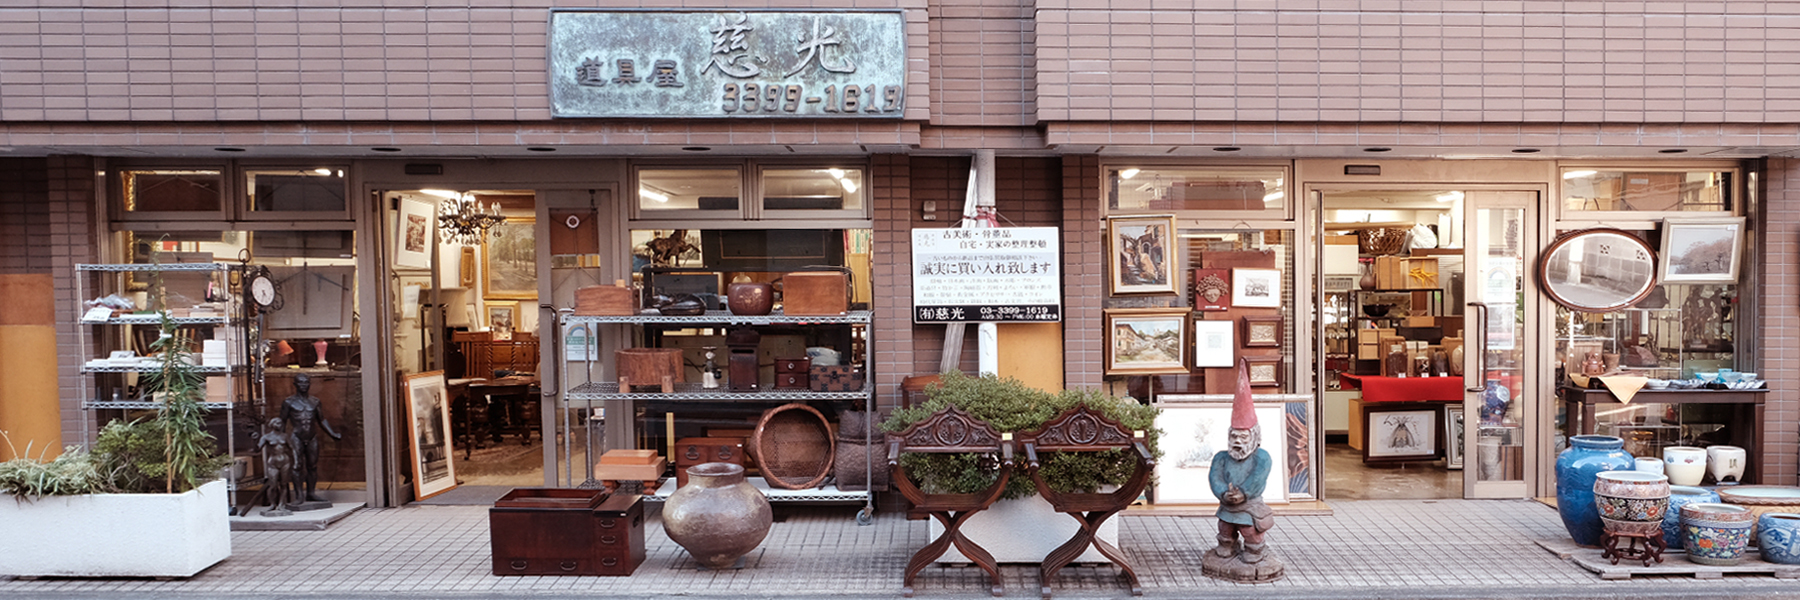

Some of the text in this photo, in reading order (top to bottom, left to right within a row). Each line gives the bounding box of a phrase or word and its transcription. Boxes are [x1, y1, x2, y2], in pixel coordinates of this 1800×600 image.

[575, 11, 856, 88] 道具屋 慈光
[721, 83, 902, 114] 3399-1619
[920, 262, 1052, 275] 誠実に買い入れ致します
[980, 306, 1048, 314] 03-3399-1619
